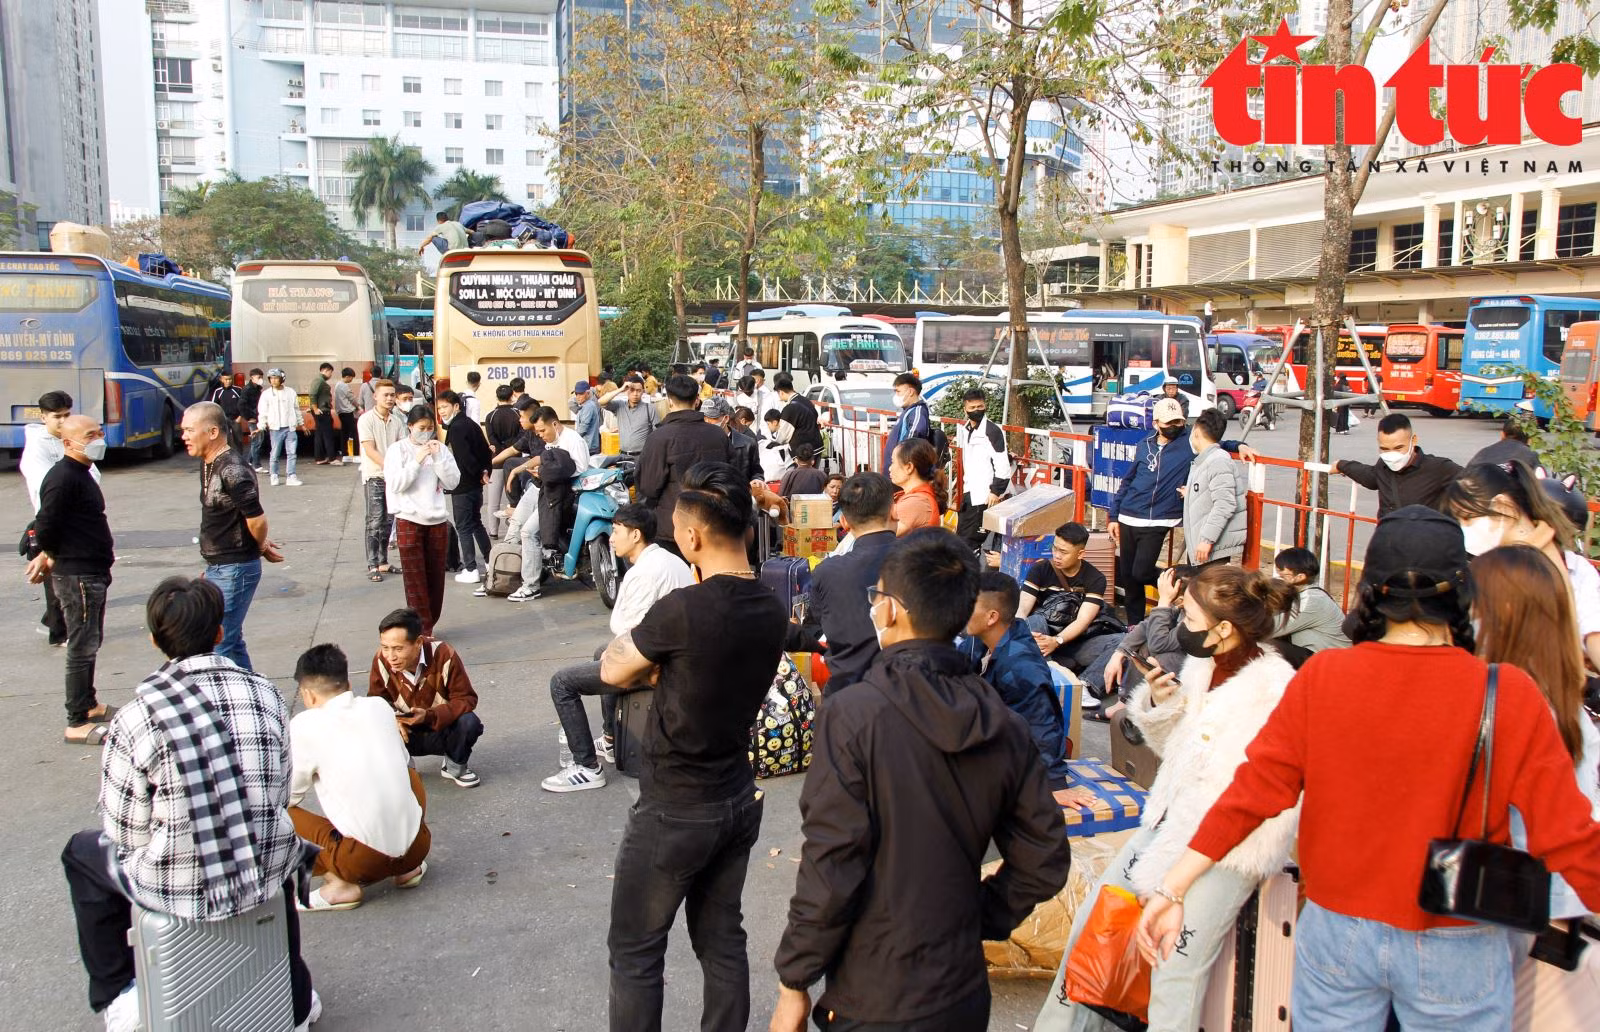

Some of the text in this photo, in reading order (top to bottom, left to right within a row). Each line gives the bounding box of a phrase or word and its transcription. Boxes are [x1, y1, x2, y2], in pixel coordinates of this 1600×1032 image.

[521, 273, 550, 287] THUẬN
[551, 273, 574, 285] CHÂU
[477, 288, 488, 299] LA
[515, 287, 537, 299] CHÂU
[50, 350, 72, 360] 025
